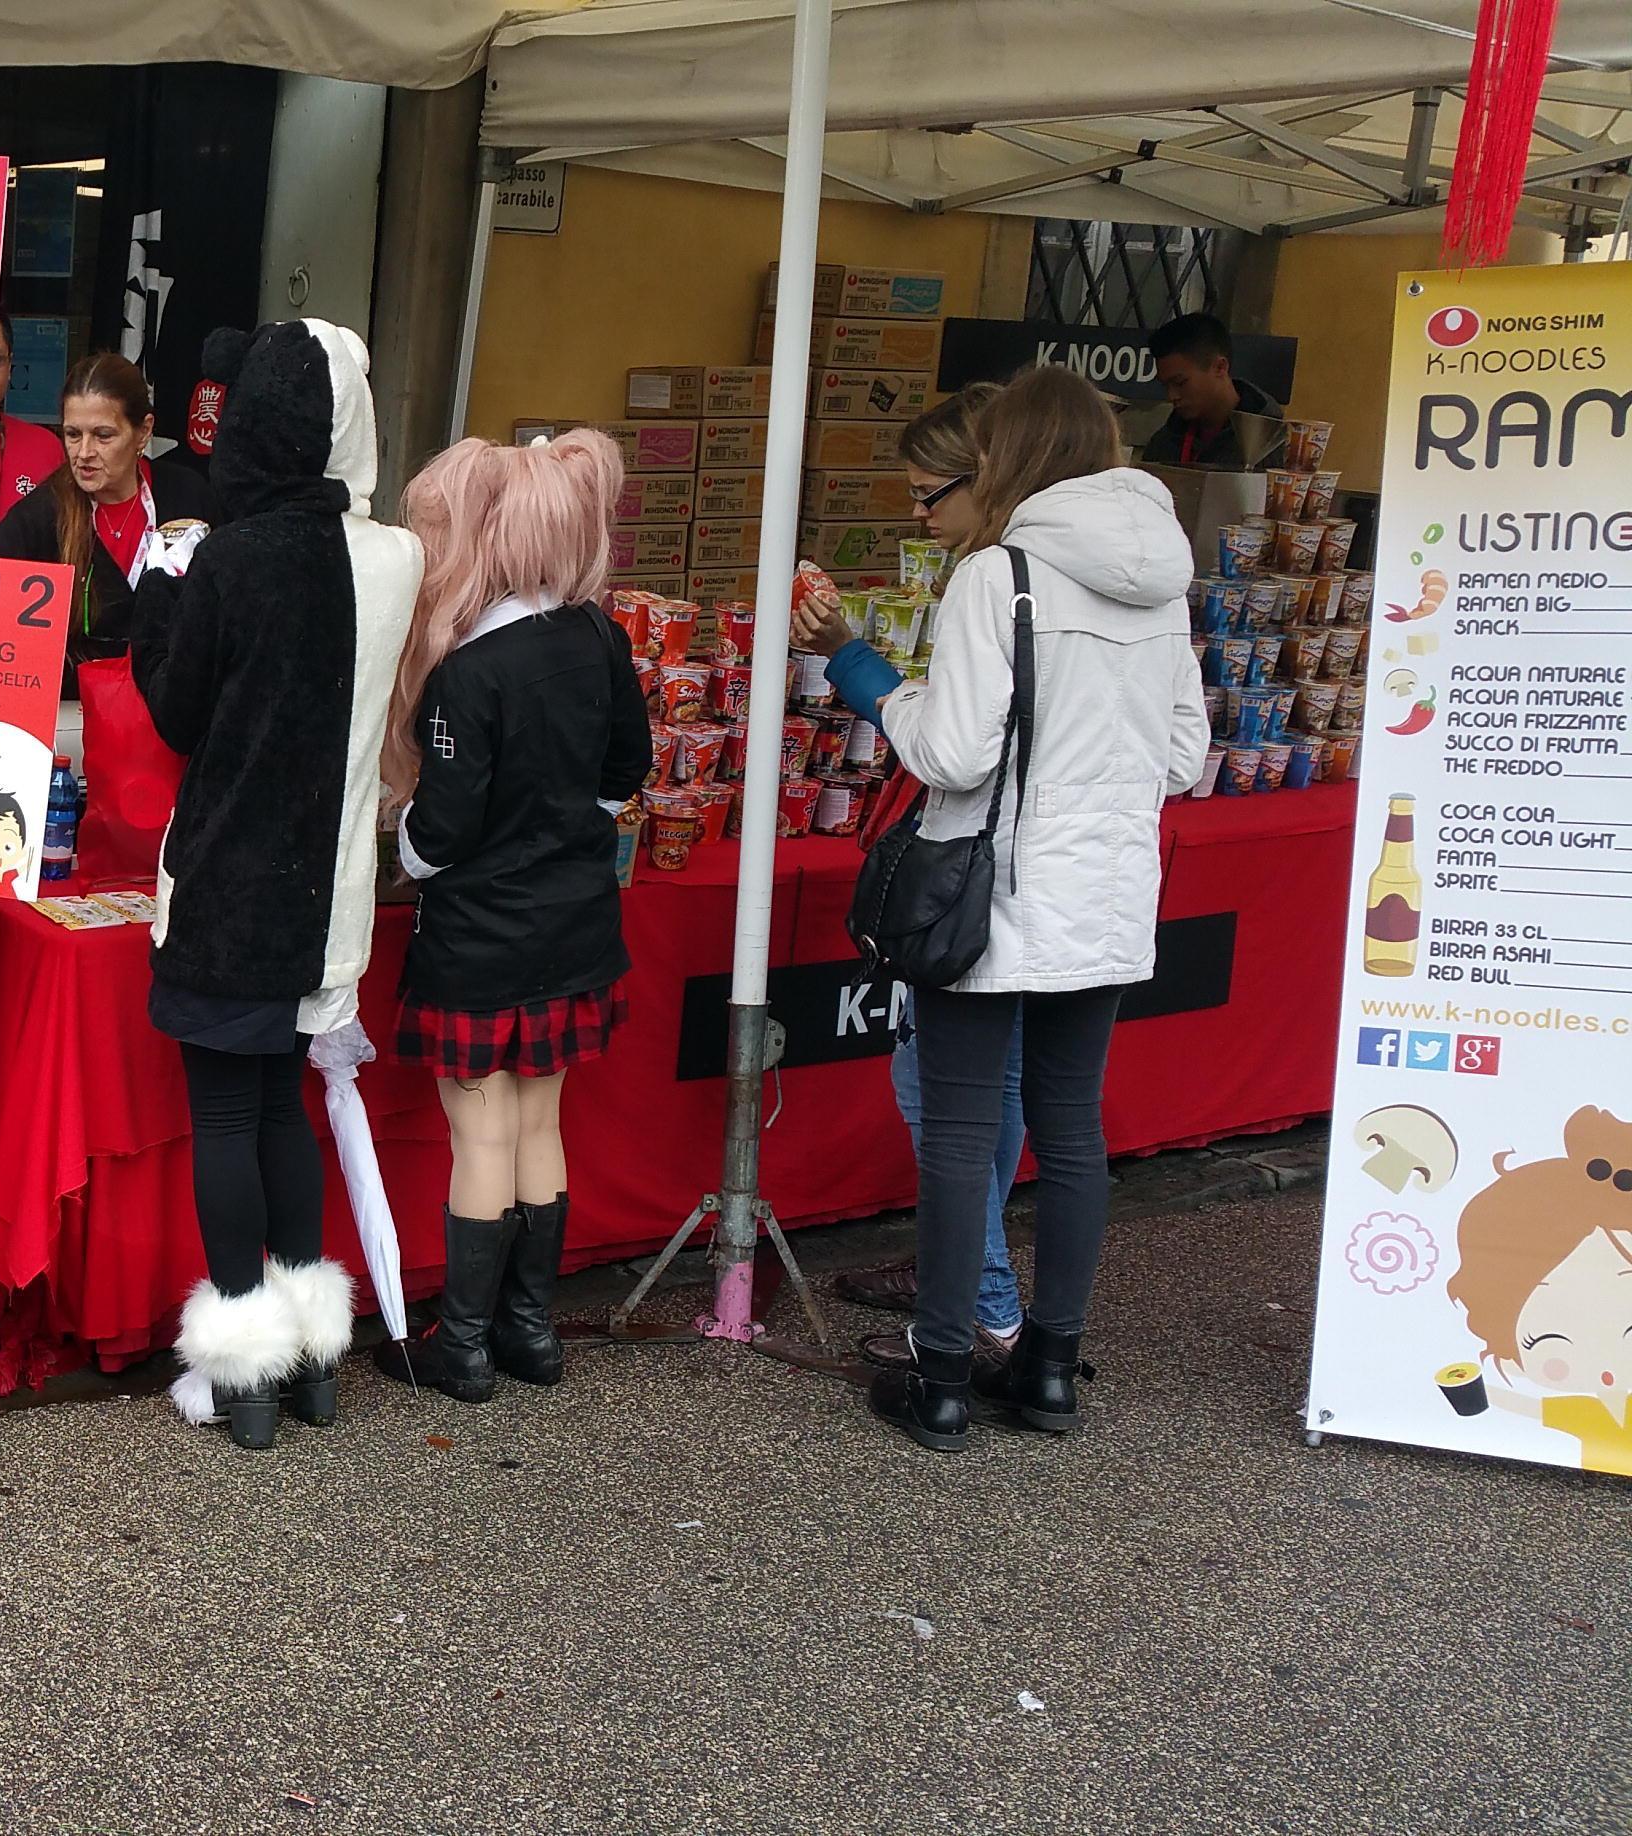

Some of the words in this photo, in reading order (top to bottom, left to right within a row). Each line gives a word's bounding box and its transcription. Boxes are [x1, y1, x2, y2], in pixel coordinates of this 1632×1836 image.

[1426, 347, 1606, 376] K-NOODLES
[718, 427, 750, 435] NONGSHIM
[1458, 573, 1530, 589] RAMEN
[1538, 573, 1608, 589] MEDIO
[16, 575, 56, 629] 2
[1456, 596, 1529, 612] RAMEN
[1536, 597, 1572, 612] BIG
[1454, 619, 1520, 635] SNACK
[1450, 665, 1521, 682] ACQUA
[1528, 666, 1626, 684] NATURALE
[1449, 689, 1519, 706] ACQUA
[1525, 689, 1624, 707] NATURALE
[1447, 712, 1517, 729] ACQUA
[1525, 713, 1627, 731] FRIZZANTE
[1445, 735, 1513, 753] SUCCO
[1520, 736, 1539, 753] DI
[1546, 737, 1618, 755] FRUTTA
[1443, 757, 1478, 774] THE
[1483, 759, 1563, 777] FREDDO
[1440, 804, 1497, 821] COCA
[1502, 805, 1555, 823] COLA
[1438, 826, 1495, 844] COCA
[1501, 829, 1553, 847] COLA
[1560, 830, 1616, 850] LIGHT
[1437, 850, 1497, 867] FANTA
[1434, 872, 1498, 892] SPRITE
[1431, 919, 1489, 937] BIRRA
[1495, 923, 1517, 939] 33
[1522, 924, 1548, 940] CL
[1429, 942, 1487, 961] BIRRA
[1493, 944, 1551, 964] ASAHI
[1427, 965, 1464, 982] RED
[1471, 967, 1512, 986] BULL
